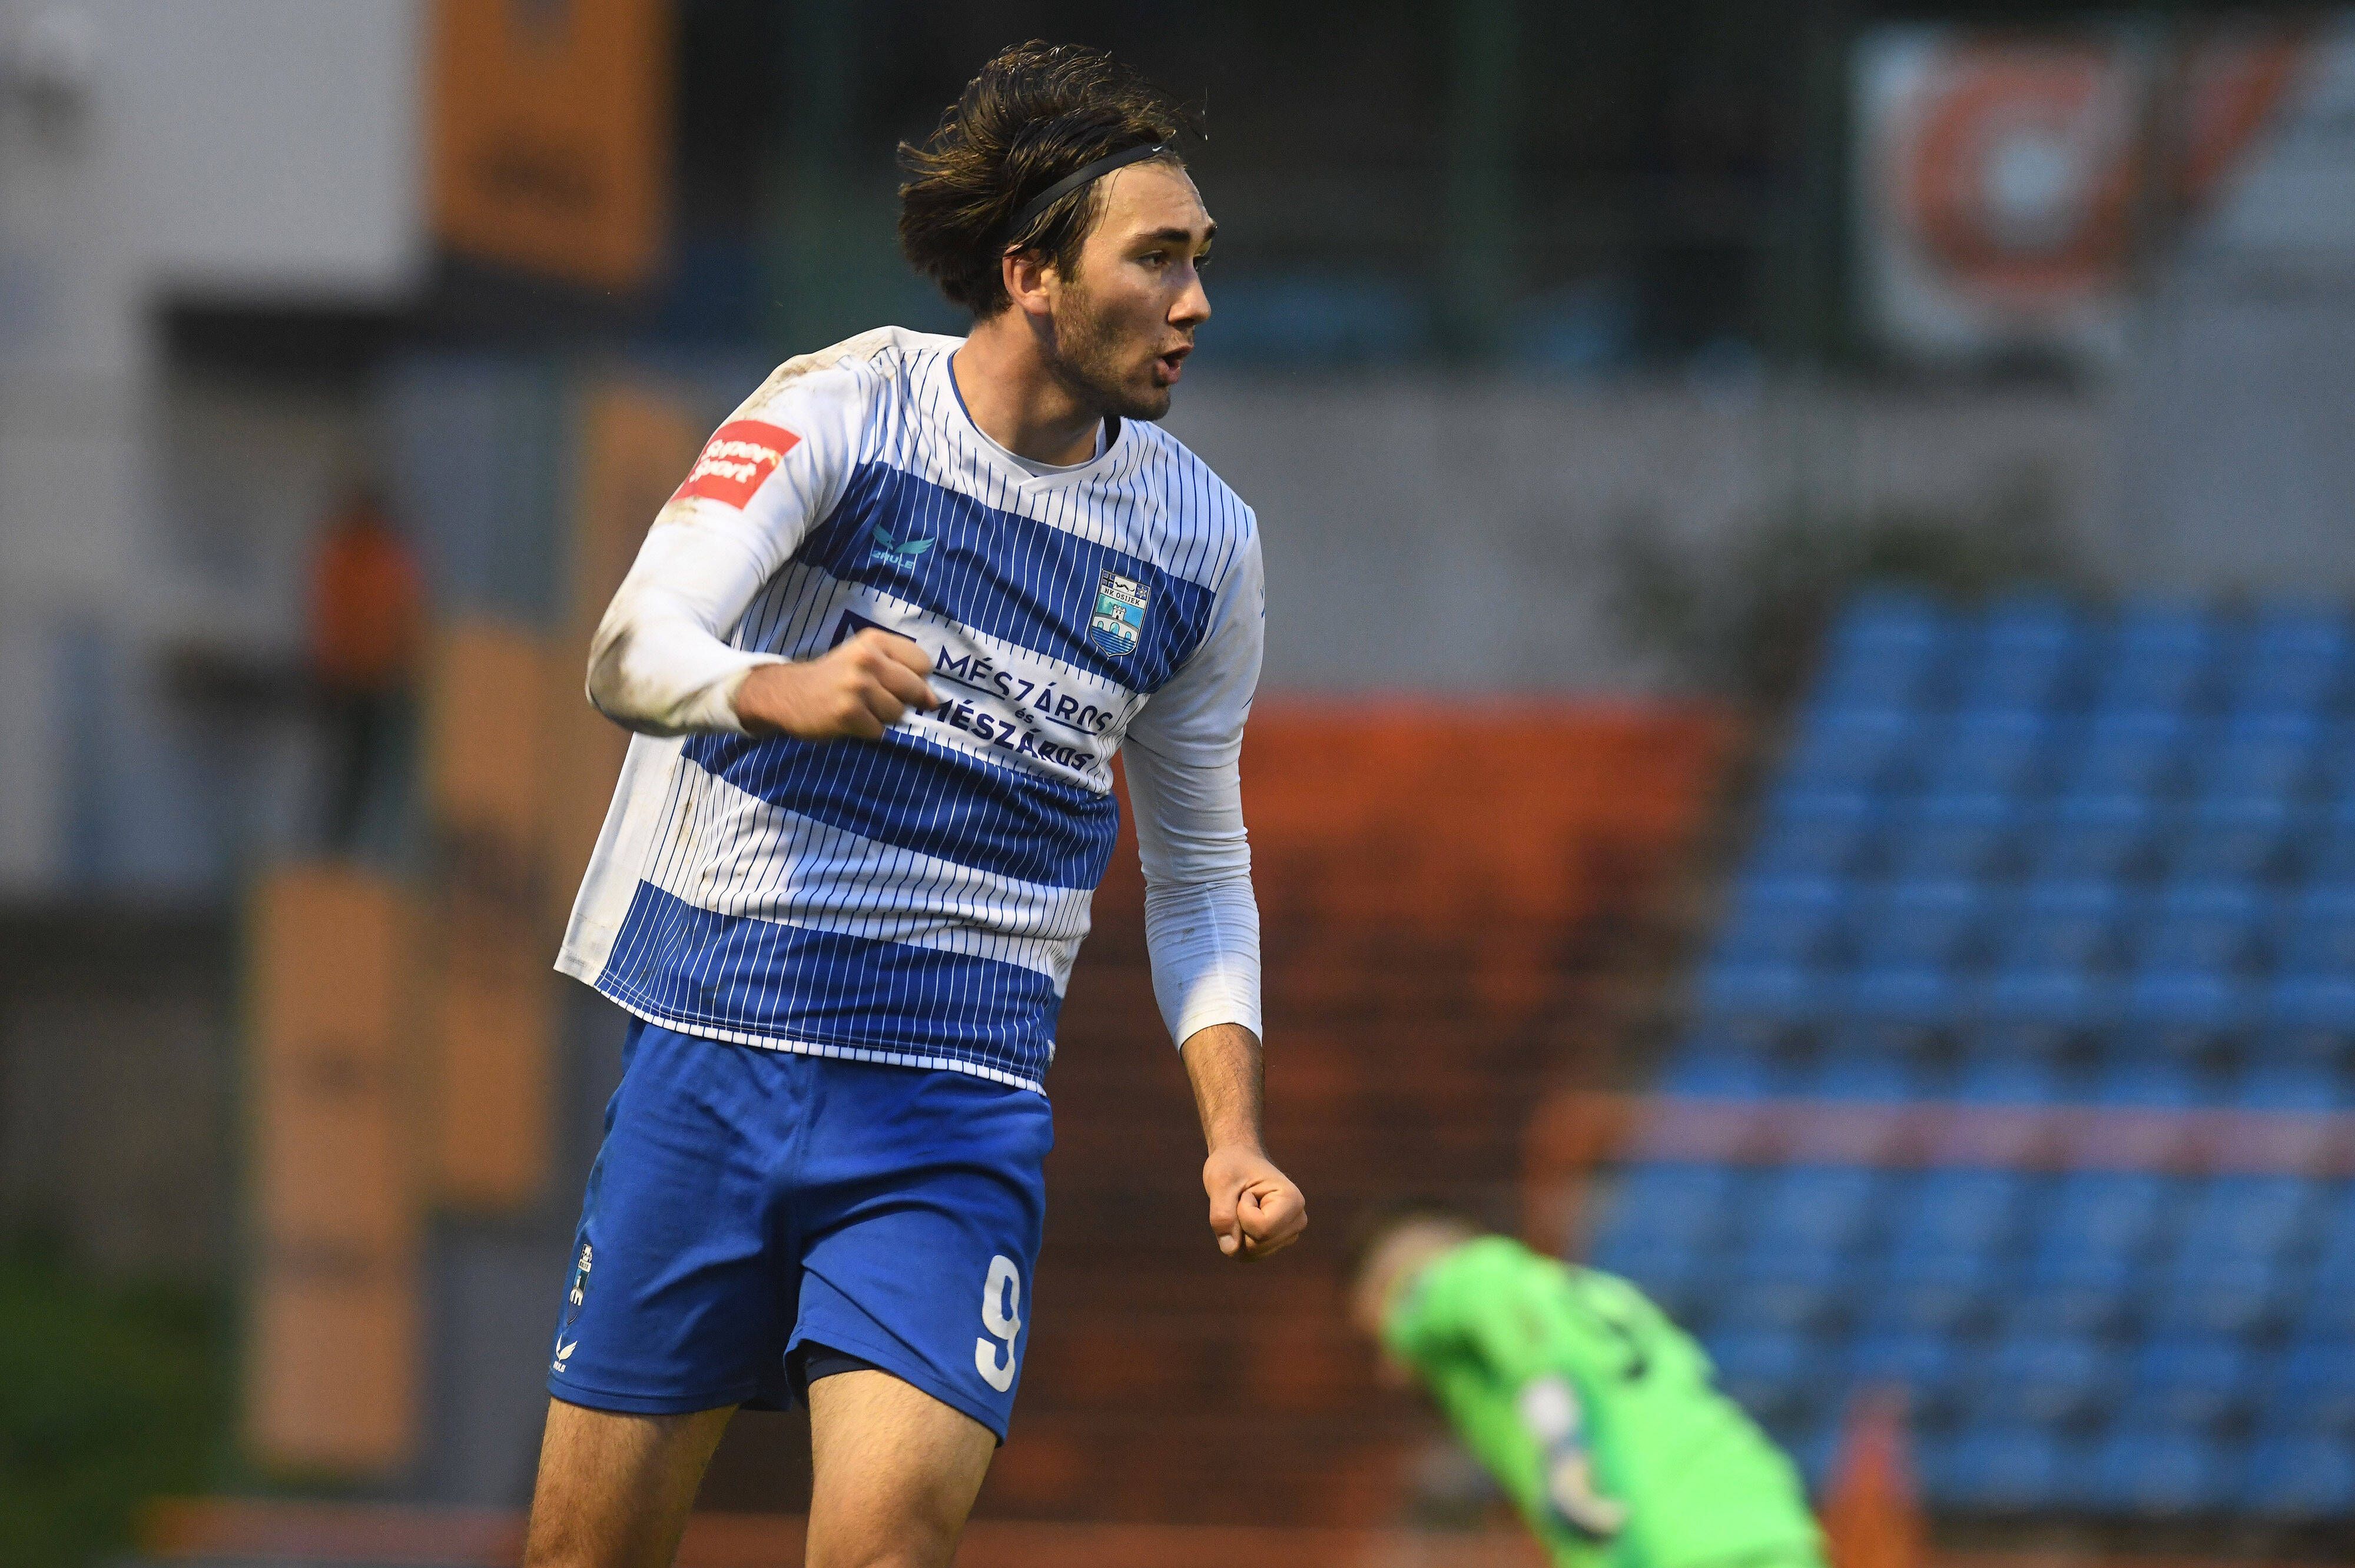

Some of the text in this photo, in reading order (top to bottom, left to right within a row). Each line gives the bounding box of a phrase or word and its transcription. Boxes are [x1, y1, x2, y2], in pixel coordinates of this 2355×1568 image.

[1104, 587, 1140, 606] NK OSIJEK
[1015, 707, 1033, 724] és
[974, 1254, 1021, 1393] 9
